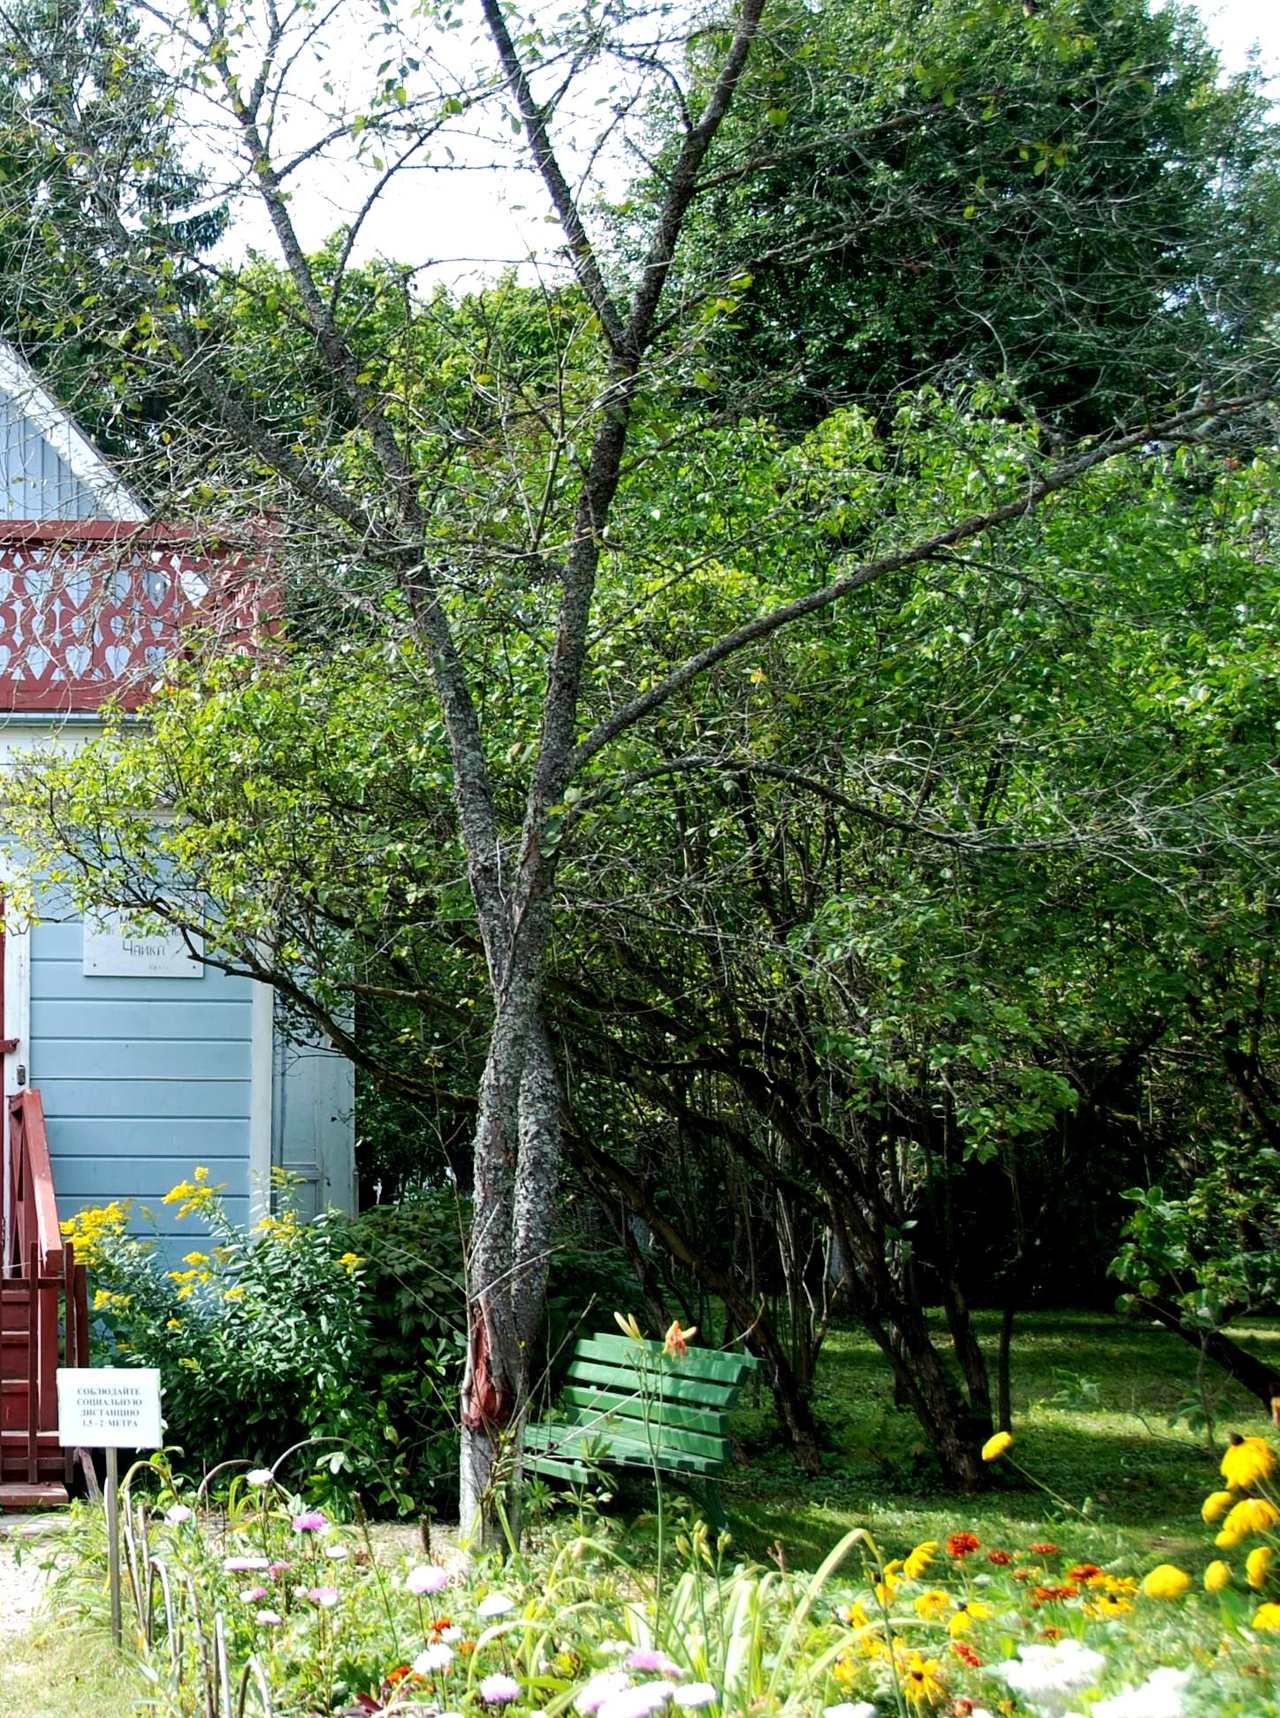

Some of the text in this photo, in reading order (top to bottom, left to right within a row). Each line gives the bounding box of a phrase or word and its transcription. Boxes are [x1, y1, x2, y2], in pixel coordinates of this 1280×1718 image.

[77, 1387, 141, 1396] СОБЛЮДАЙТЕ
[77, 1398, 142, 1407] СОЦИАЛЬНУЮ
[81, 1409, 140, 1417] ДИСТАНЦИЮ
[100, 1419, 104, 1427] 2
[108, 1419, 138, 1427] МЕТРА
